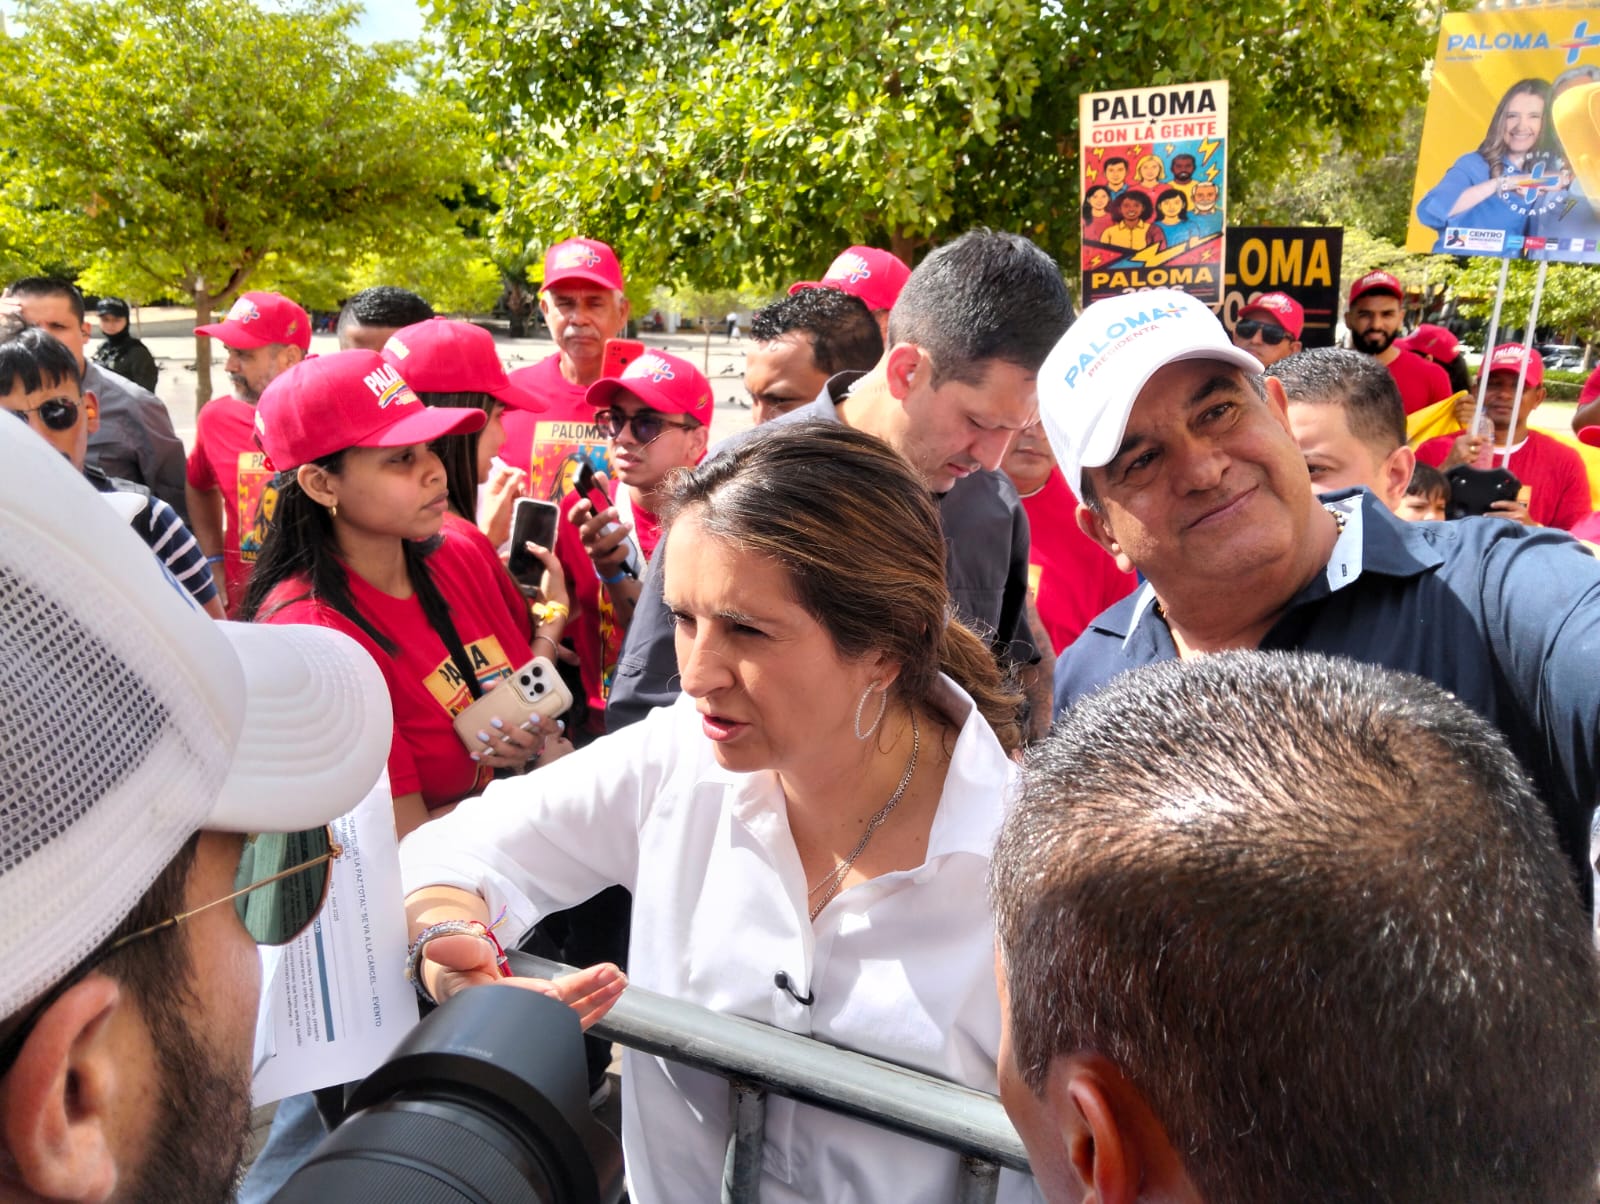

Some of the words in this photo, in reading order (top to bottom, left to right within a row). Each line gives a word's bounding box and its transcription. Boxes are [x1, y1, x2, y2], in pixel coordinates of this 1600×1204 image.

[1447, 32, 1549, 50] PALOMA
[1092, 89, 1216, 121] PALOMA
[1092, 129, 1127, 144] CON
[1135, 127, 1154, 141] LA
[1161, 122, 1216, 138] GENTE
[1469, 230, 1503, 239] CENTRO
[1091, 268, 1213, 288] PALOMA
[1064, 307, 1171, 389] PALOMA
[1088, 324, 1159, 377] PRESIDENTA
[354, 858, 361, 867] LA
[355, 869, 363, 883] PAZ
[363, 924, 371, 934] VA
[366, 943, 373, 952] LA
[372, 996, 382, 1027] EVENTO
